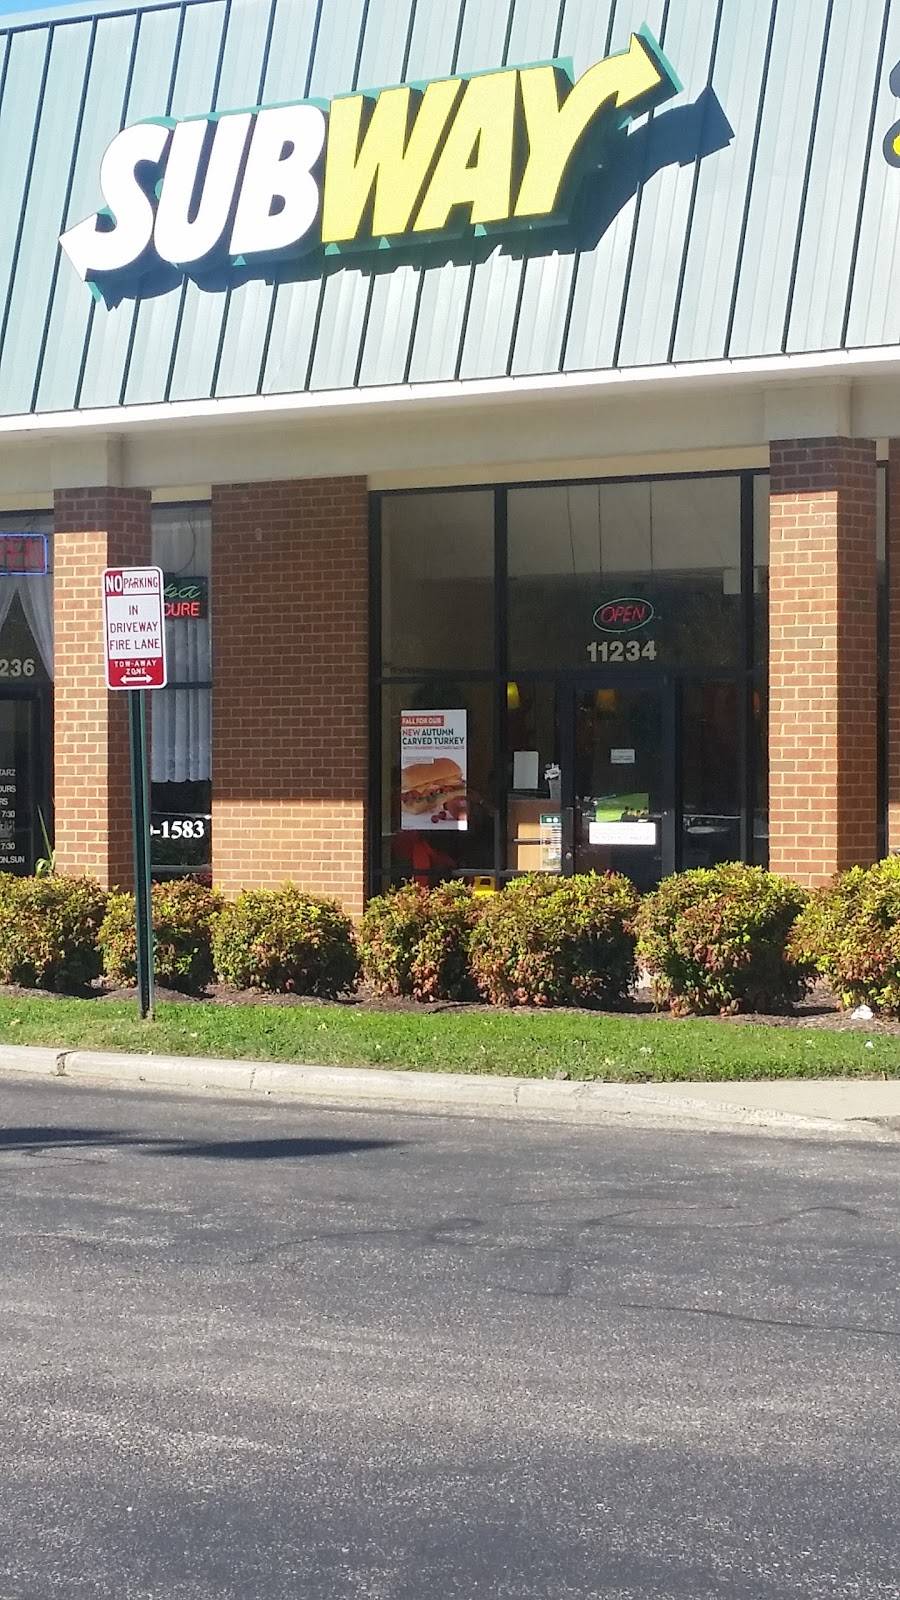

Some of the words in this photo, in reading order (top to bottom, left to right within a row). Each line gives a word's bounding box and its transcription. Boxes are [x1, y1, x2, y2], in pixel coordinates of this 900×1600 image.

[59, 33, 663, 283] SUBWAY
[106, 575, 123, 593] NO
[123, 577, 158, 589] PARKING
[128, 604, 139, 616] IN
[601, 605, 646, 624] OPEN
[109, 621, 159, 634] DRIVEWAY
[109, 639, 131, 651] FIRE
[134, 638, 161, 650] LANE
[586, 640, 657, 662] 11234
[114, 659, 157, 668] TOW-AWAY
[125, 667, 147, 676] ZONE
[402, 728, 420, 736] NEW
[421, 728, 454, 736] AUTUMN
[402, 737, 433, 745] CARVED
[433, 737, 465, 745] TURKEY
